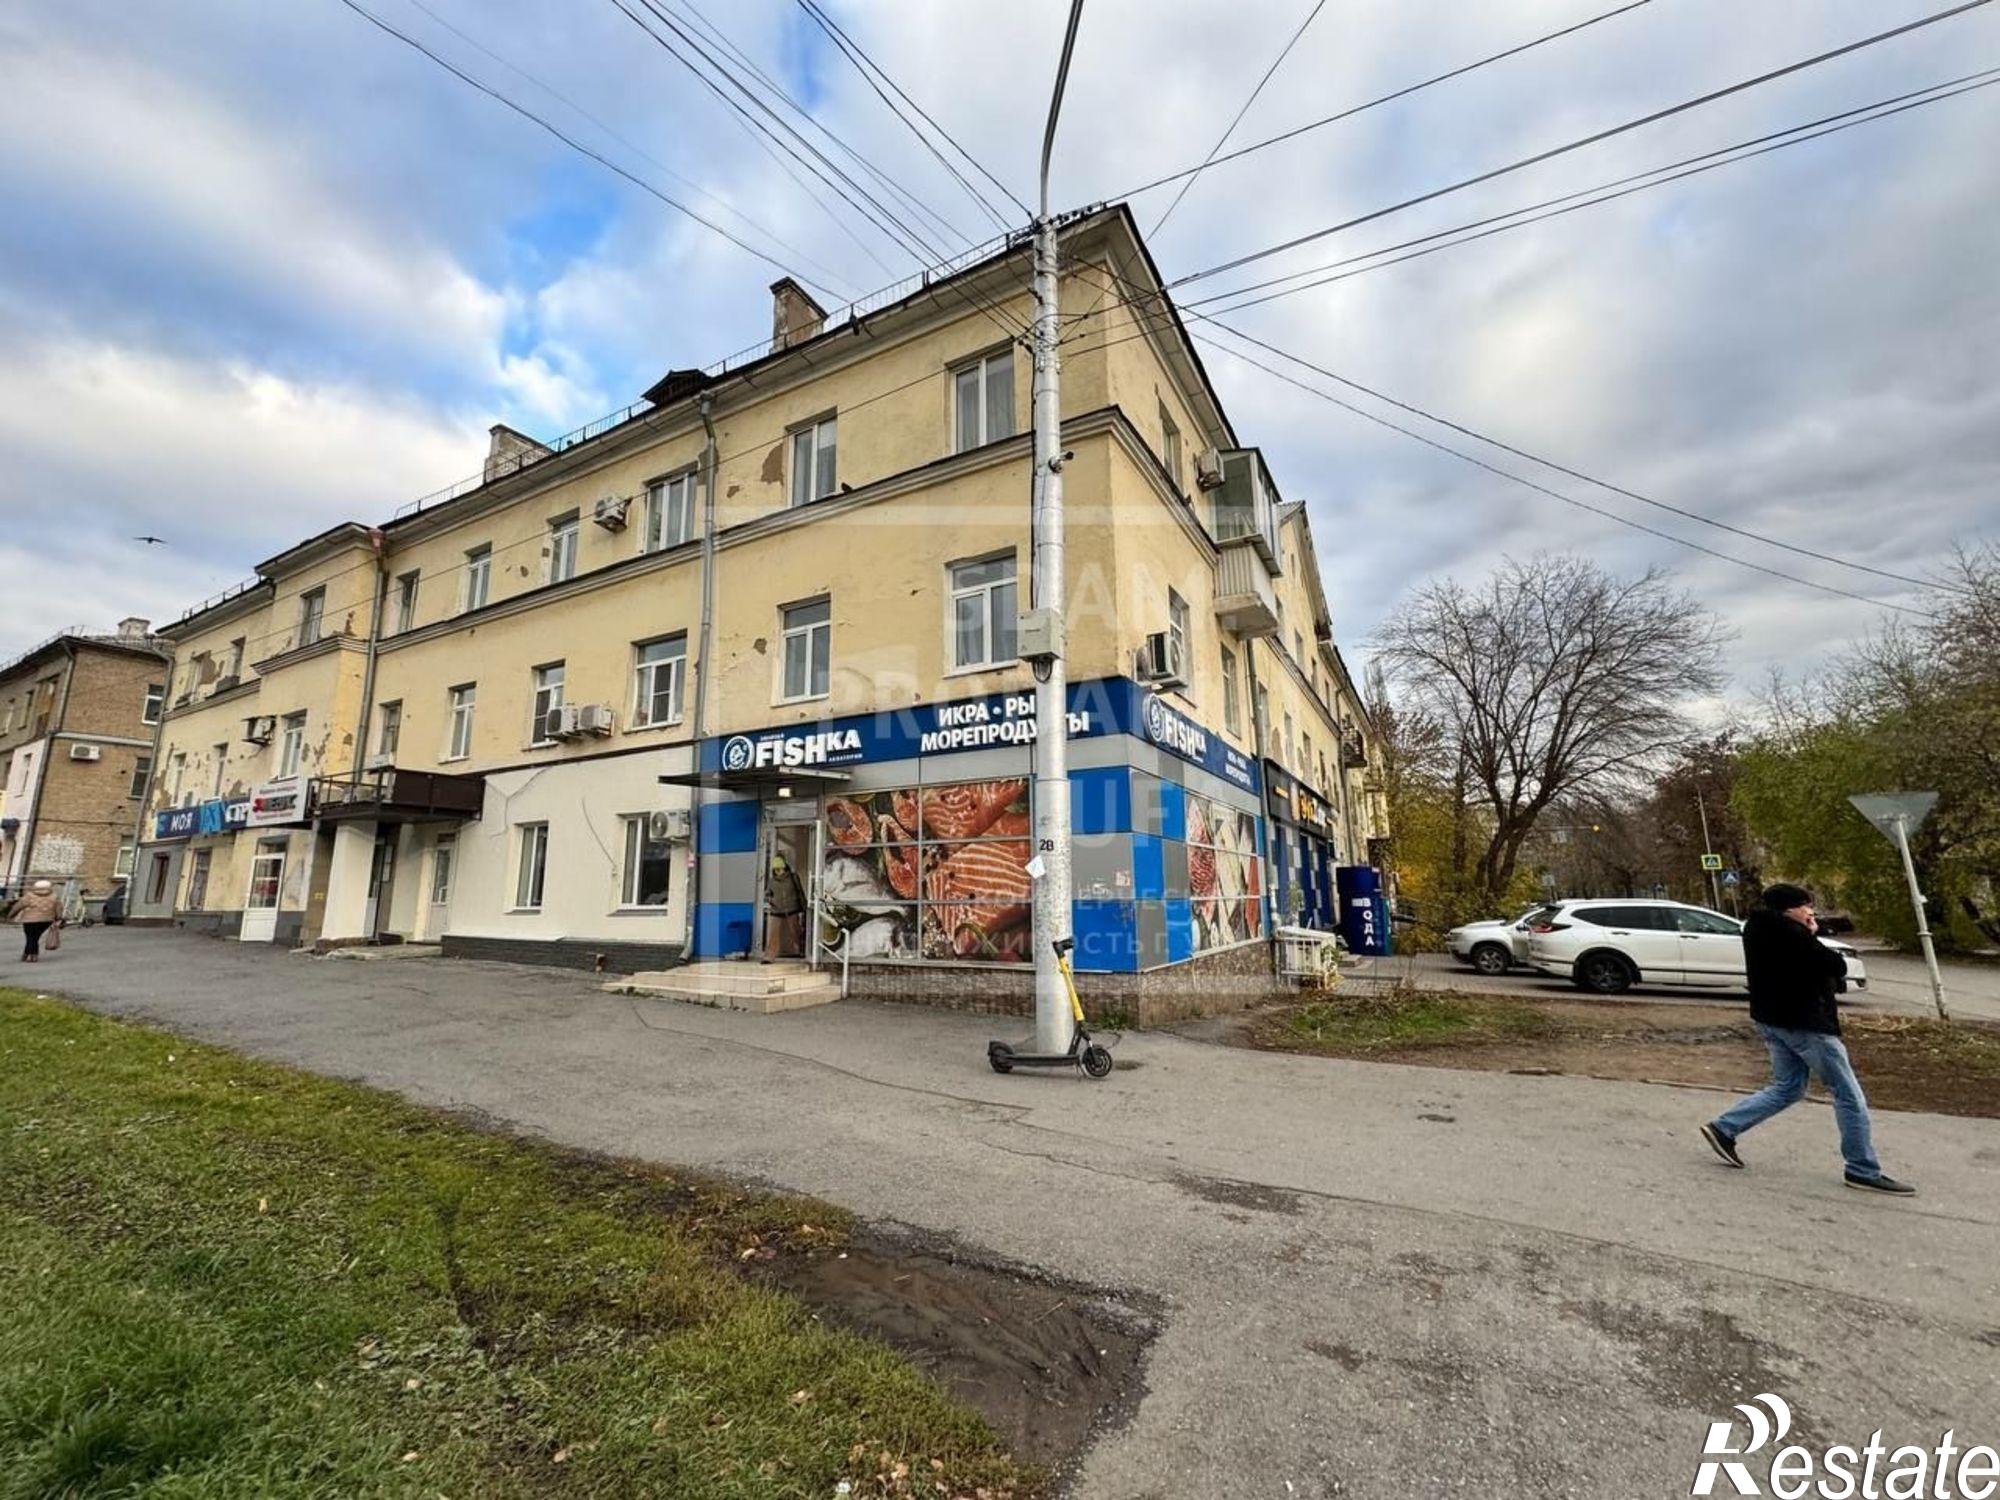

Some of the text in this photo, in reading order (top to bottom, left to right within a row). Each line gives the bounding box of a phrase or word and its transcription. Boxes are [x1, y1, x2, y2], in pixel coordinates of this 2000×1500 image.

[938, 694, 1036, 727] ИКРА РЫ
[755, 729, 862, 768] FISHKA
[920, 711, 1091, 752] МОРЕПРОДУЫ
[1362, 897, 1375, 947] ВОДА
